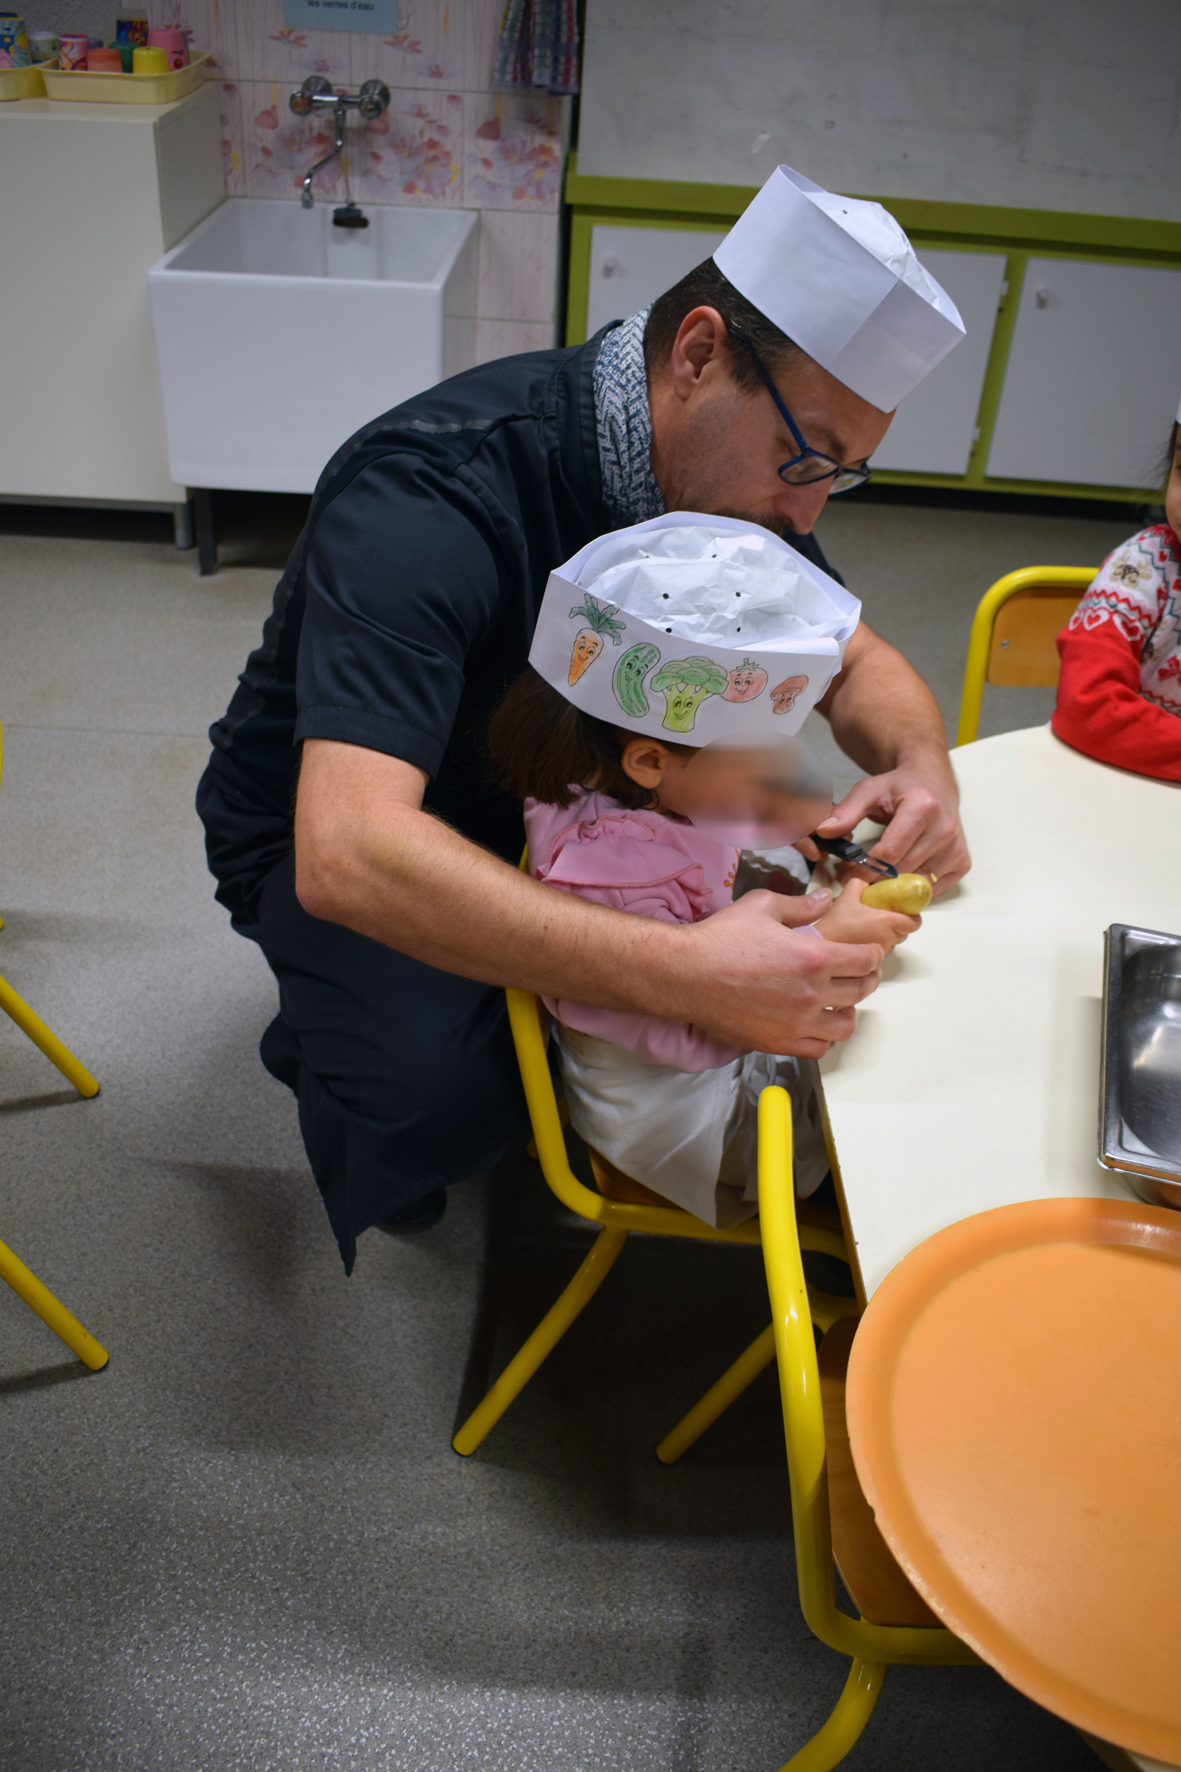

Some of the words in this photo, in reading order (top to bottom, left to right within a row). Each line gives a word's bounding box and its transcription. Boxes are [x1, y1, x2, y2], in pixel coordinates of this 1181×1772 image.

[307, 0, 320, 8] les
[322, 1, 348, 9] verres
[350, 1, 375, 11] d'eau
